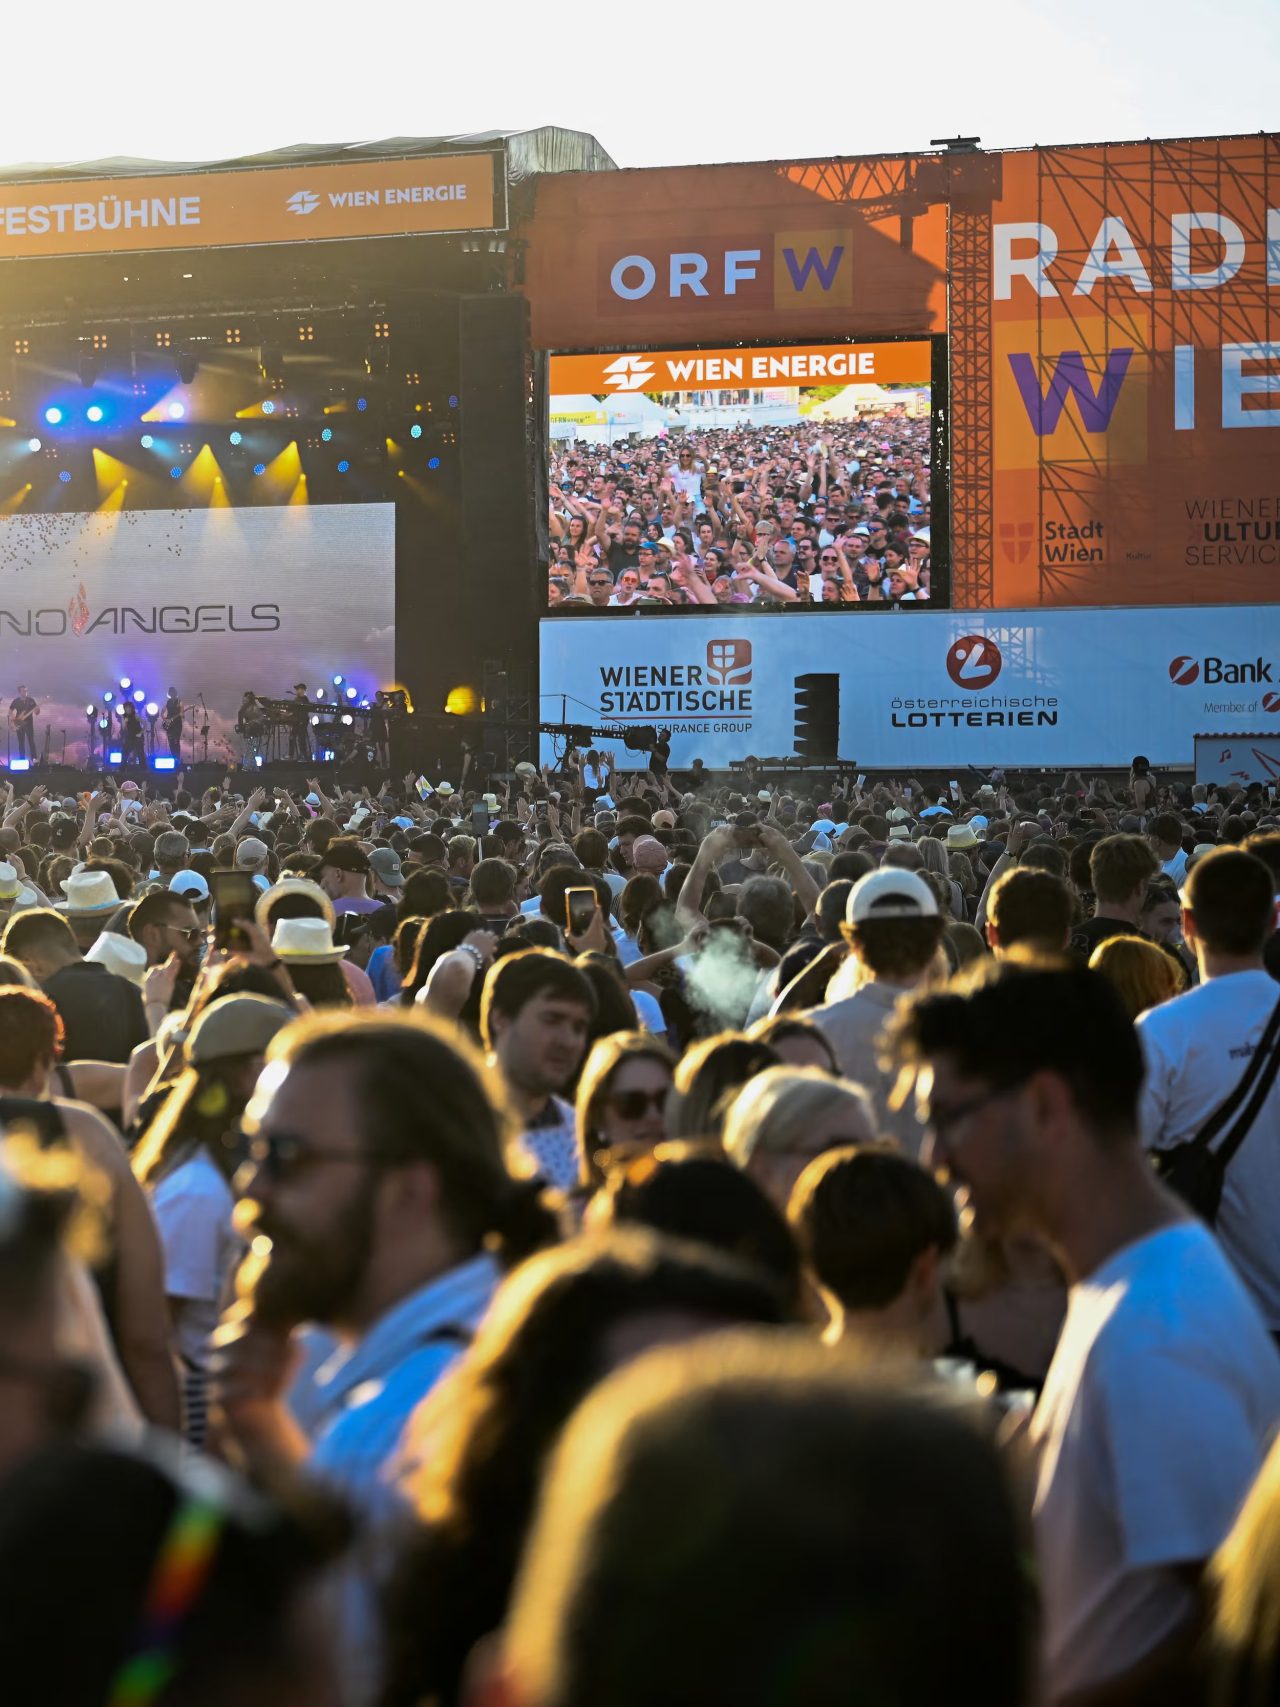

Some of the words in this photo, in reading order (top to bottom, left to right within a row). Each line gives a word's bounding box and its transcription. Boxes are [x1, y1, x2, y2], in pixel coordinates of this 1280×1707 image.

[328, 190, 379, 209] WIEN
[385, 184, 467, 205] ENERGIE
[610, 250, 761, 301] ORF
[782, 246, 845, 292] W
[666, 358, 743, 382] WIEN
[752, 353, 874, 379] ENERGIE
[1184, 498, 1280, 520] WIENE
[1045, 520, 1104, 540] Stadt
[1044, 543, 1104, 563] Wien
[1184, 545, 1280, 567] SERVIC
[84, 604, 280, 635] ANGELS
[600, 665, 702, 687] WIENER
[1204, 657, 1273, 684] Bank
[600, 690, 752, 712] STÄDTISCHE
[891, 695, 1058, 709] österreichische
[1204, 702, 1245, 713] Member
[1248, 701, 1258, 713] of
[713, 724, 752, 733] GROUP
[891, 711, 1058, 727] LOTTERIEN
